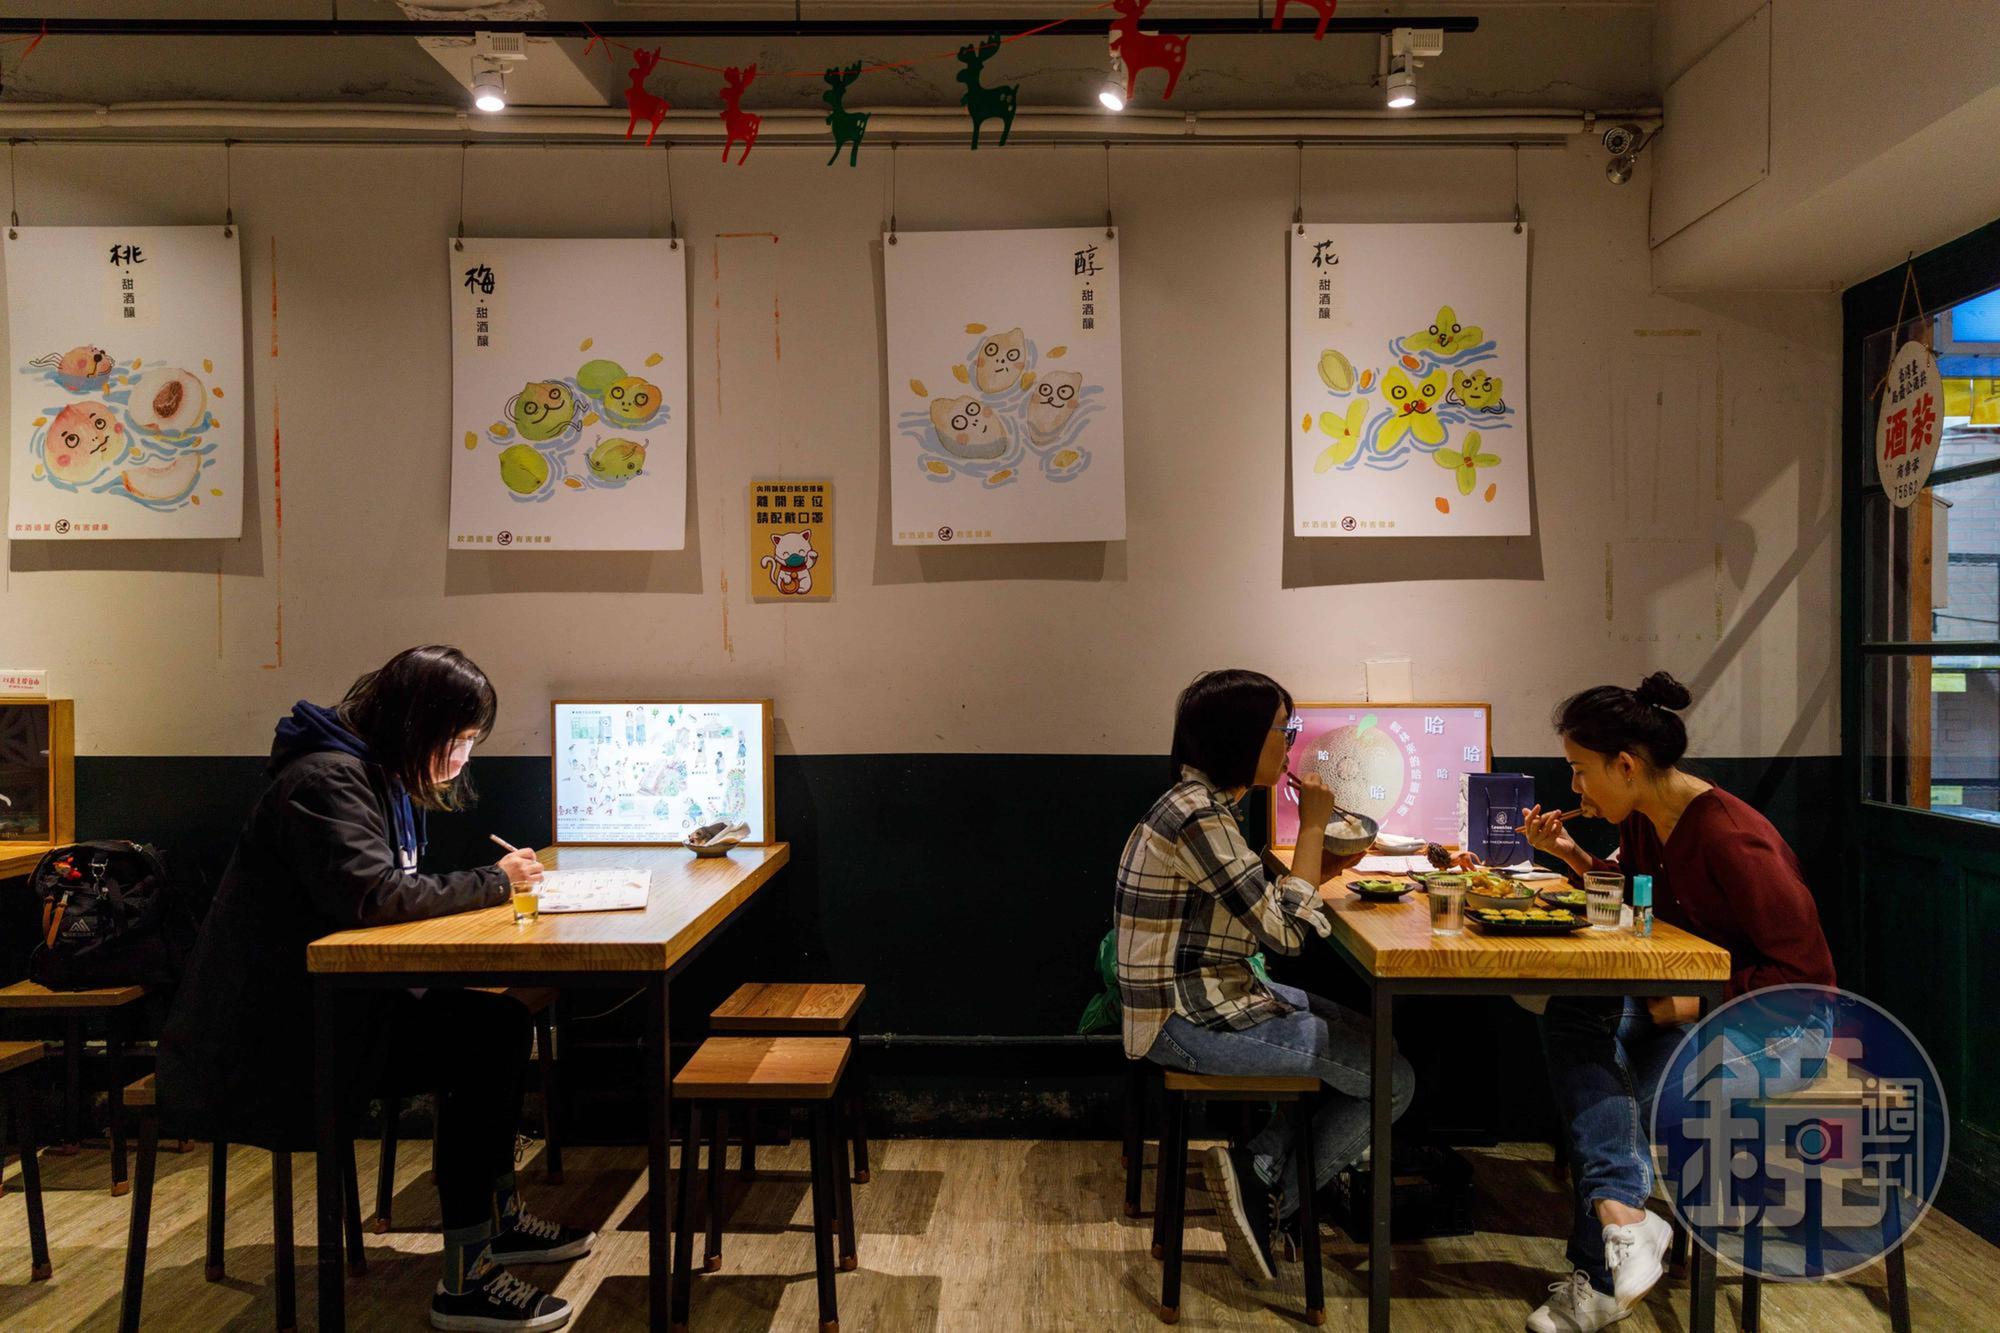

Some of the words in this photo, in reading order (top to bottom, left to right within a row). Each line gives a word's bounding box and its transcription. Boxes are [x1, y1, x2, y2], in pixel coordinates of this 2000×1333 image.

[110, 244, 147, 266] 桃
[1074, 244, 1103, 276] 醇
[1312, 239, 1339, 268] 花
[464, 264, 495, 294] 梅
[122, 278, 136, 319] 甜酒釀
[1081, 289, 1094, 330] 甜酒釀
[1318, 279, 1331, 319] 甜酒釀
[476, 307, 489, 347] 甜酒釀
[756, 495, 823, 507] 離開座位
[1424, 715, 1445, 735] 哈
[1318, 750, 1329, 761] 哈
[1464, 745, 1482, 762] 哈
[1436, 767, 1448, 780] 哈
[1370, 785, 1386, 800] 哈
